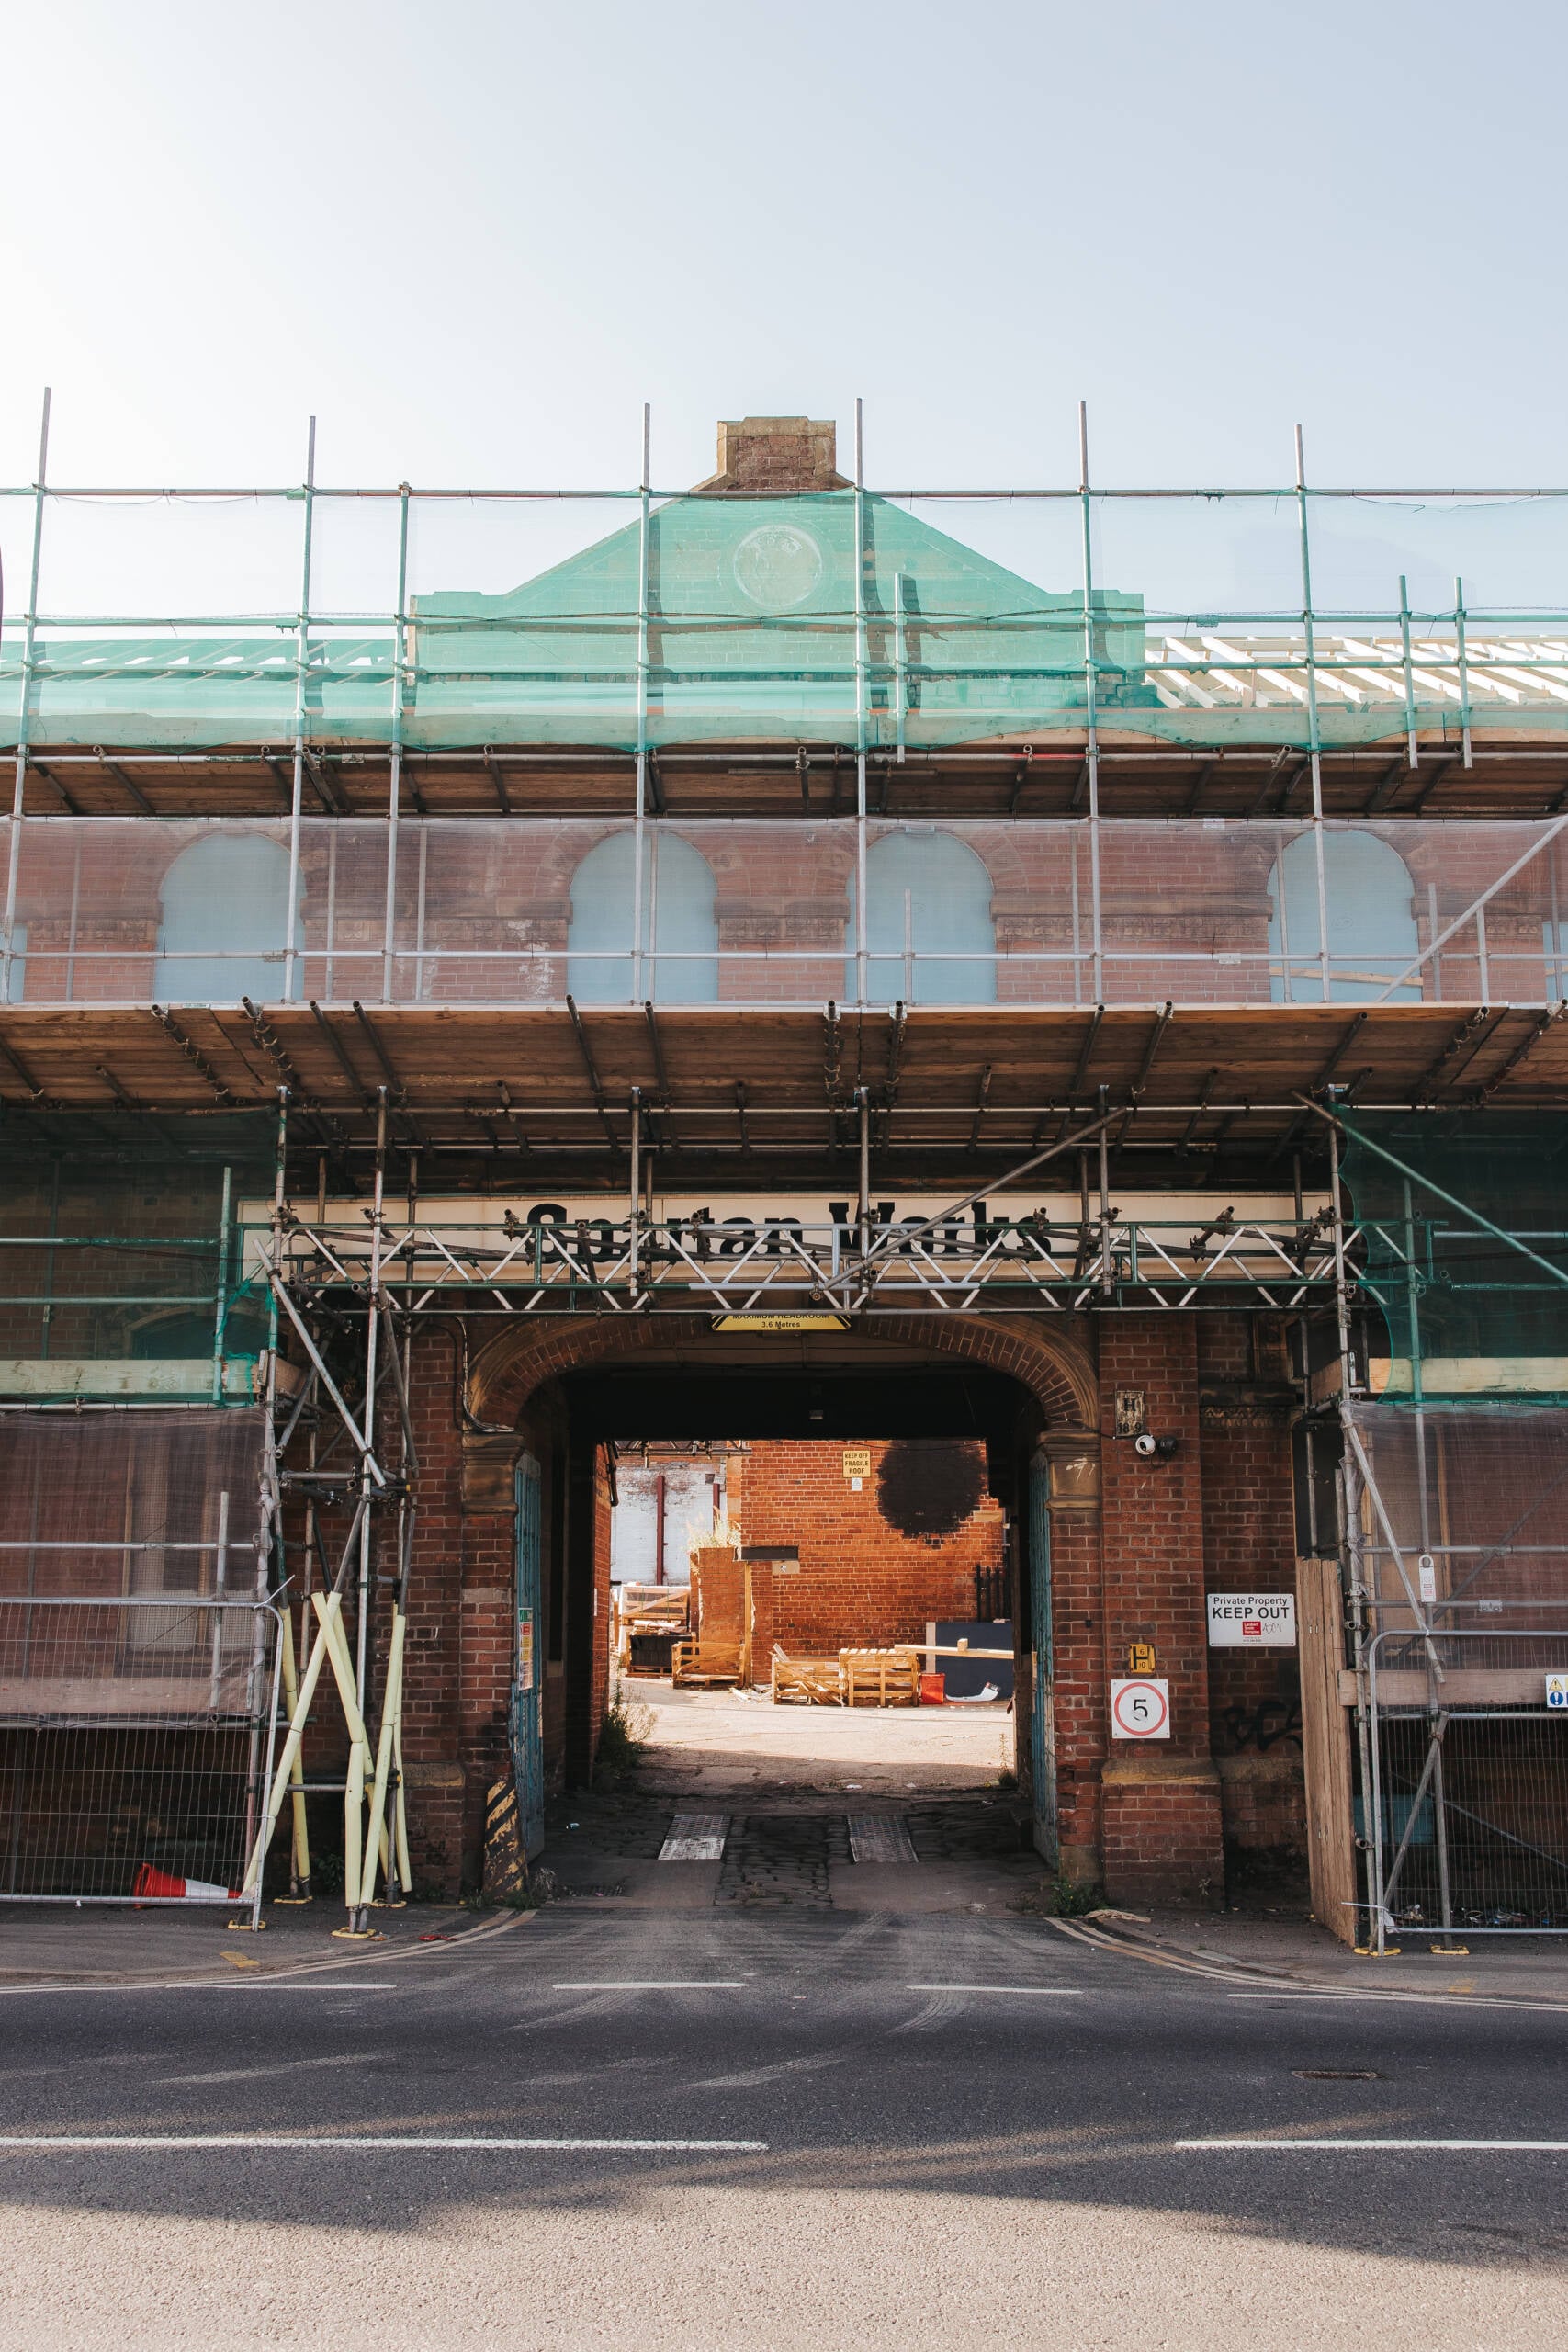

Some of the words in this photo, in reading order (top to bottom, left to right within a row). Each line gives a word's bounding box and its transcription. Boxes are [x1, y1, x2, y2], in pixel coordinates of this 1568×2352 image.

[829, 1202, 1052, 1261] Works
[1123, 1397, 1136, 1411] H
[1213, 1597, 1246, 1605] Private
[1248, 1597, 1288, 1606] Property
[1213, 1607, 1253, 1619] KEEP
[1258, 1607, 1290, 1619] OUT
[1133, 1699, 1148, 1722] 5
